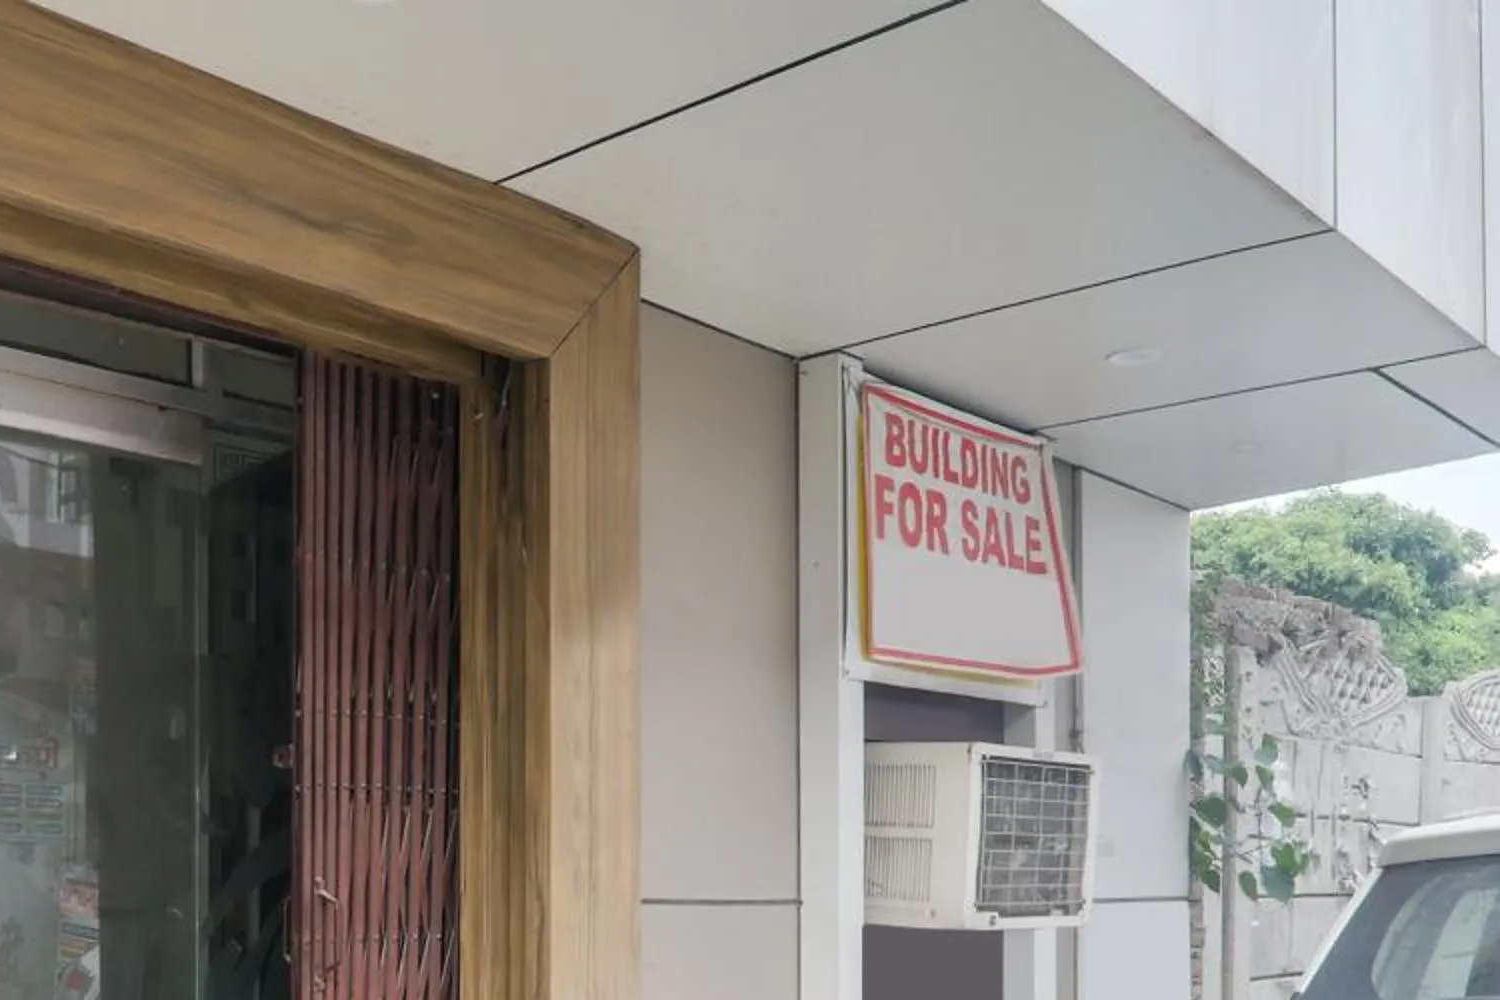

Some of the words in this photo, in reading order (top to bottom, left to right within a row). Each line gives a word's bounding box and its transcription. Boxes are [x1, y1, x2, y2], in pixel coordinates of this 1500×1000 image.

[885, 412, 1031, 504] BUILDING
[875, 475, 949, 554] FOR
[961, 500, 1047, 574] SALE
